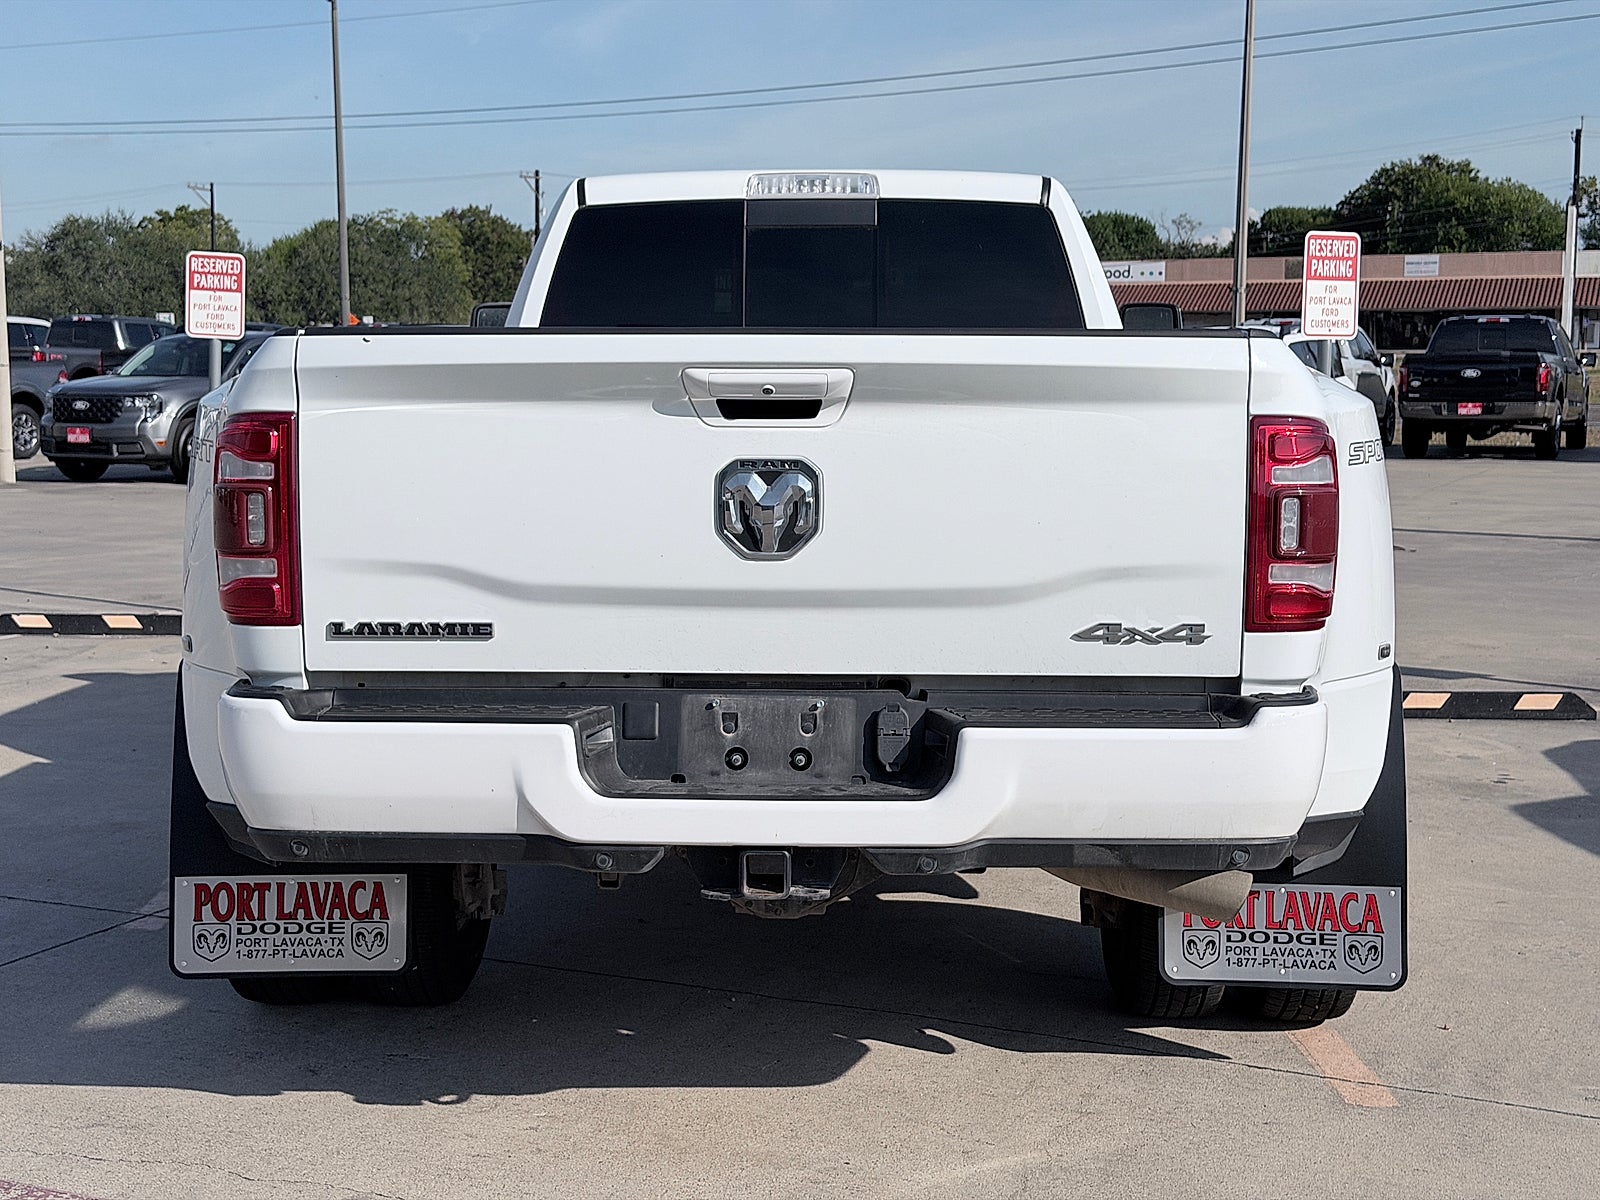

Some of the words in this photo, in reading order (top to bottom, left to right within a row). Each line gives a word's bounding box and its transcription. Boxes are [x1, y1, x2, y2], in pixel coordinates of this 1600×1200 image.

[1310, 239, 1356, 258] RESERVED
[191, 257, 241, 274] RESERVED
[1311, 259, 1353, 277] PARKING
[193, 274, 238, 290] PARKING
[1325, 285, 1338, 294] FOR
[1309, 296, 1326, 305] PORT
[1328, 297, 1352, 306] LAVACA
[193, 303, 211, 311] PORT
[213, 304, 238, 312] LAVACA
[1321, 308, 1339, 317] FORD
[195, 321, 236, 330] CUSTOMERS
[1310, 319, 1349, 329] CUSTOMERS
[738, 459, 801, 470] RAM
[326, 621, 494, 642] LARAMIE
[193, 882, 272, 922] PORT
[275, 880, 390, 921] LAVACA
[1265, 890, 1385, 934] LAVACA
[236, 922, 346, 935] DODGE
[235, 937, 269, 948] PORT
[1226, 930, 1338, 946] DODGE
[236, 948, 345, 960] 1-877-PT-LAVACA
[1225, 946, 1259, 957] PORT
[1225, 957, 1337, 971] 1-877-PT-LAVACA
